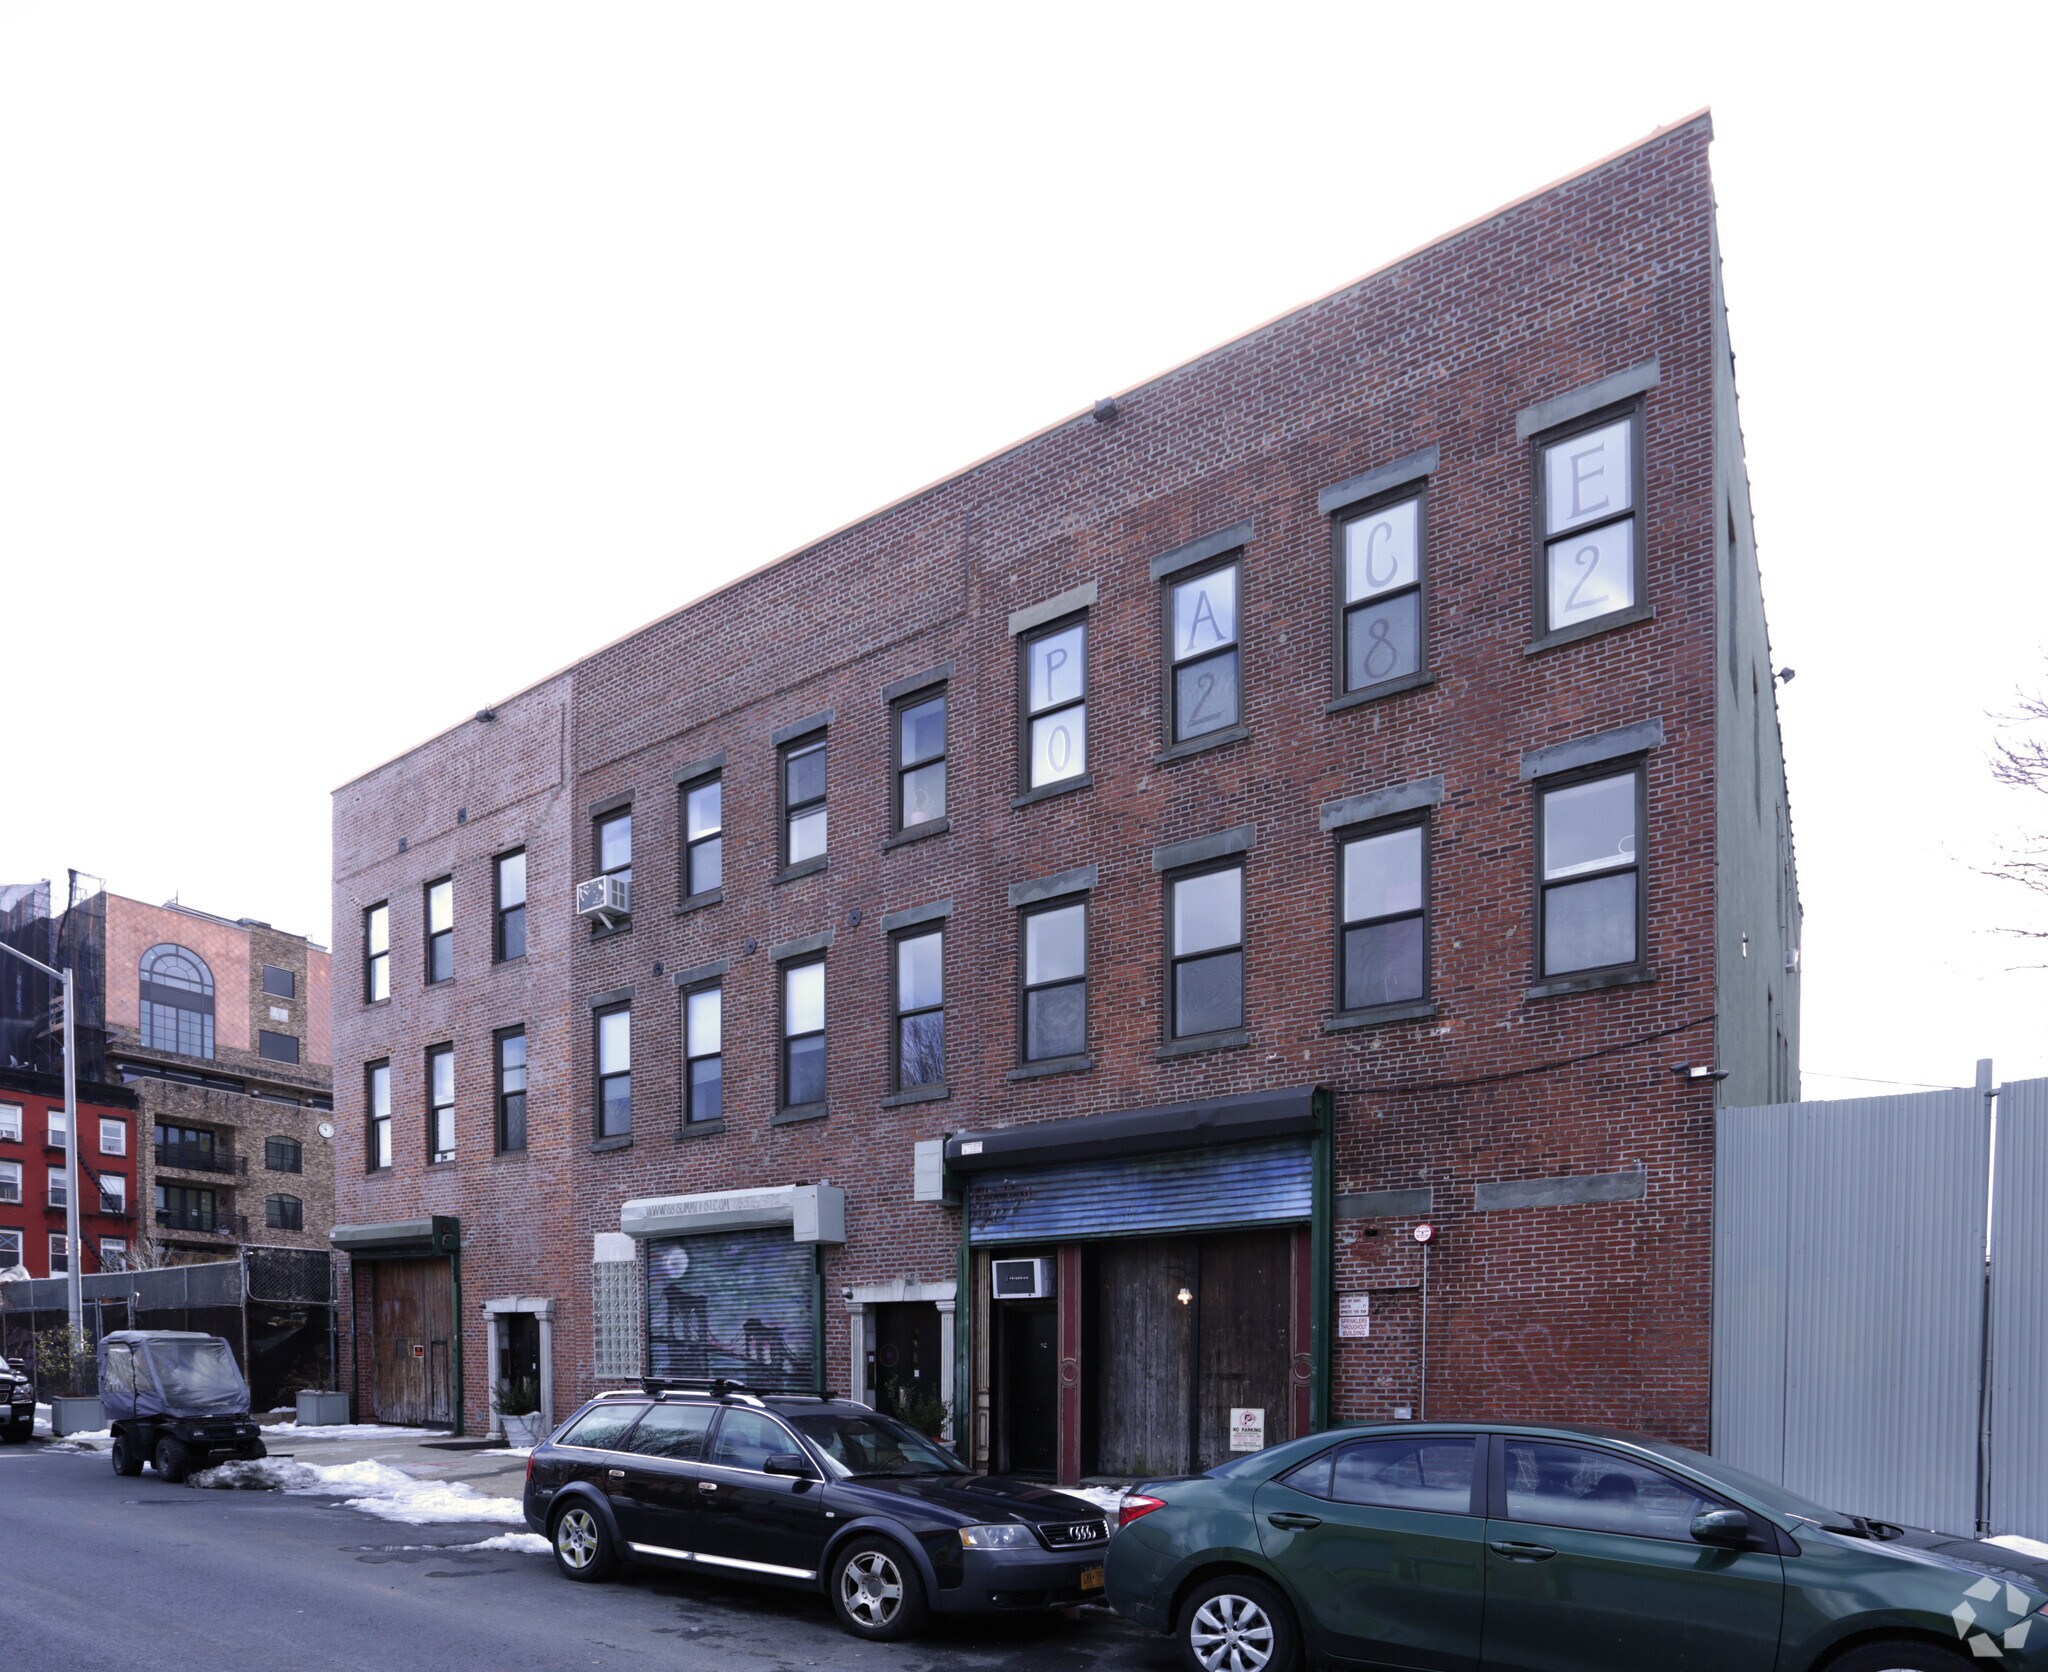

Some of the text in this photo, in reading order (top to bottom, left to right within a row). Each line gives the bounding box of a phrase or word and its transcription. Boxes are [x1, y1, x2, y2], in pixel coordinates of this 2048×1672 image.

[1045, 441, 1610, 702] P A C E
[1186, 672, 1226, 729] 2
[1363, 618, 1397, 679] 8
[1564, 545, 1610, 614] 2
